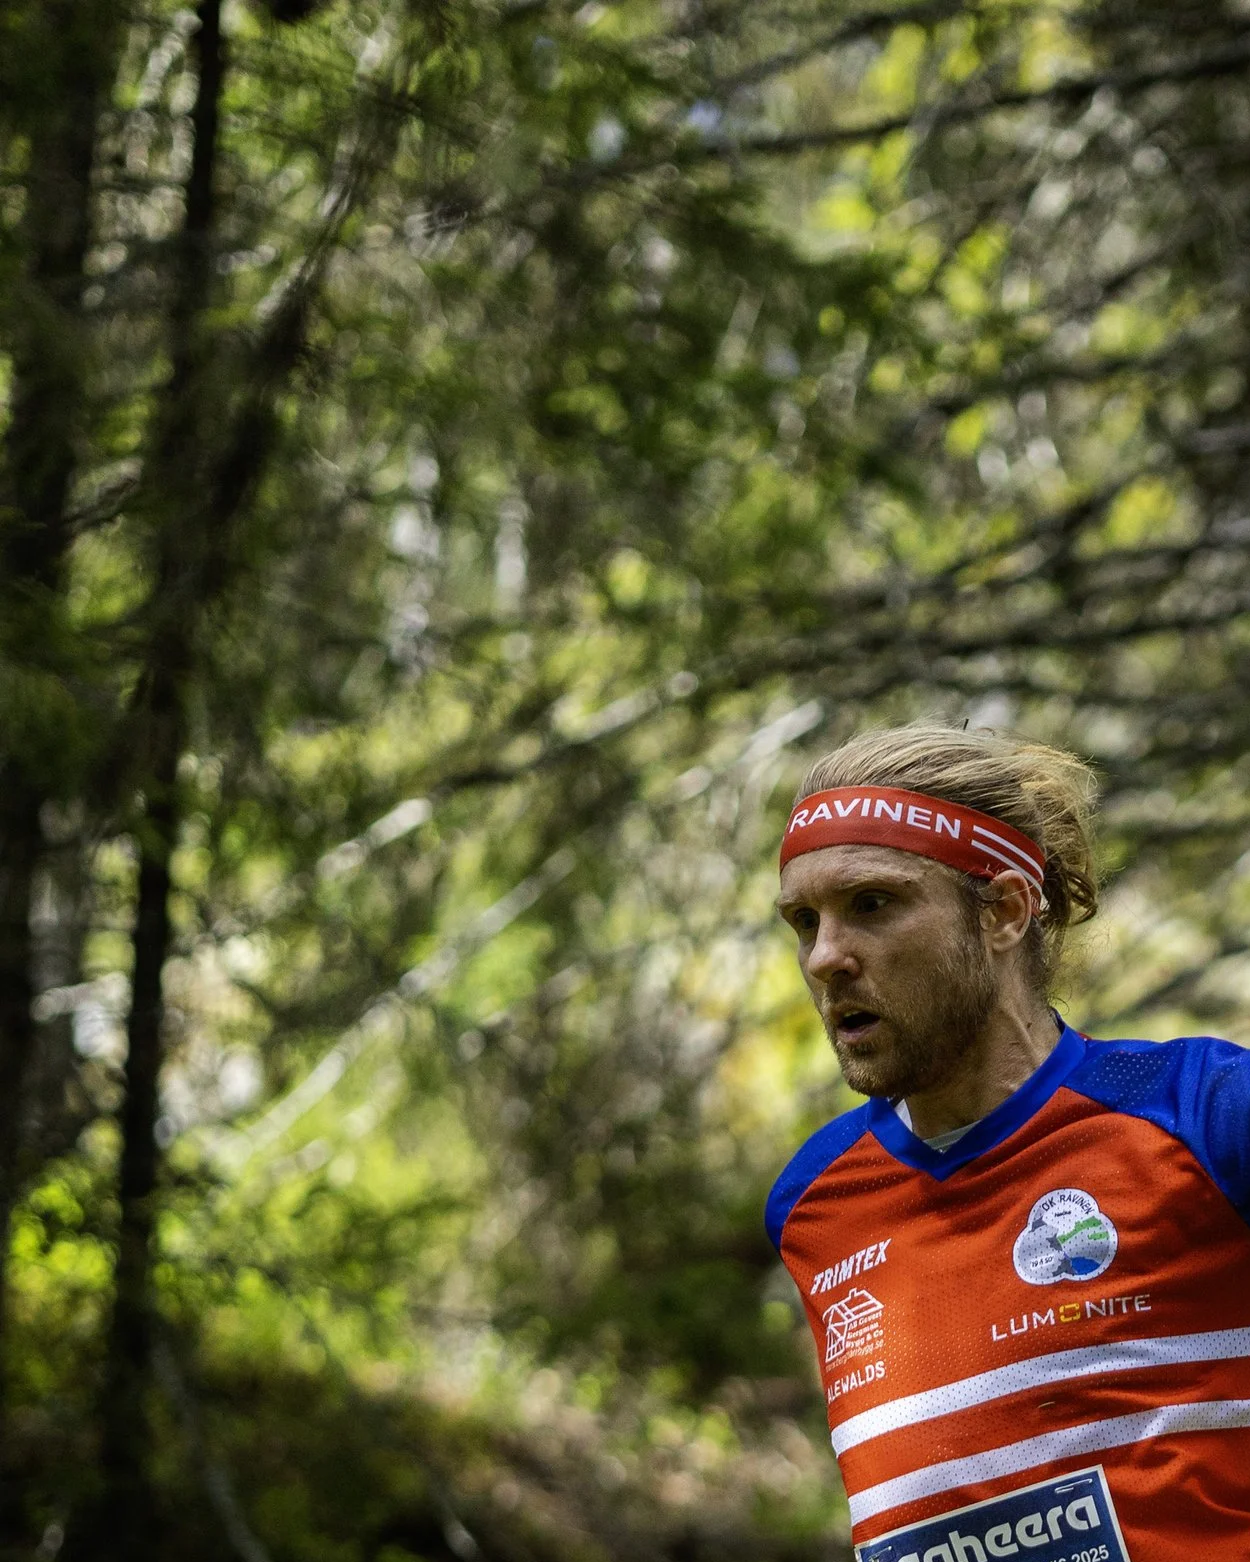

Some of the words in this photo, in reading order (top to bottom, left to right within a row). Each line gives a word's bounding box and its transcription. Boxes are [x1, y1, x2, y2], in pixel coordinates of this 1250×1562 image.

[789, 798, 961, 839] RAVINEN
[1041, 1196, 1057, 1212] OK
[810, 1238, 893, 1296] TRIMTEX
[990, 1294, 1152, 1342] LUMONITE
[827, 1360, 886, 1404] ALEWALDS
